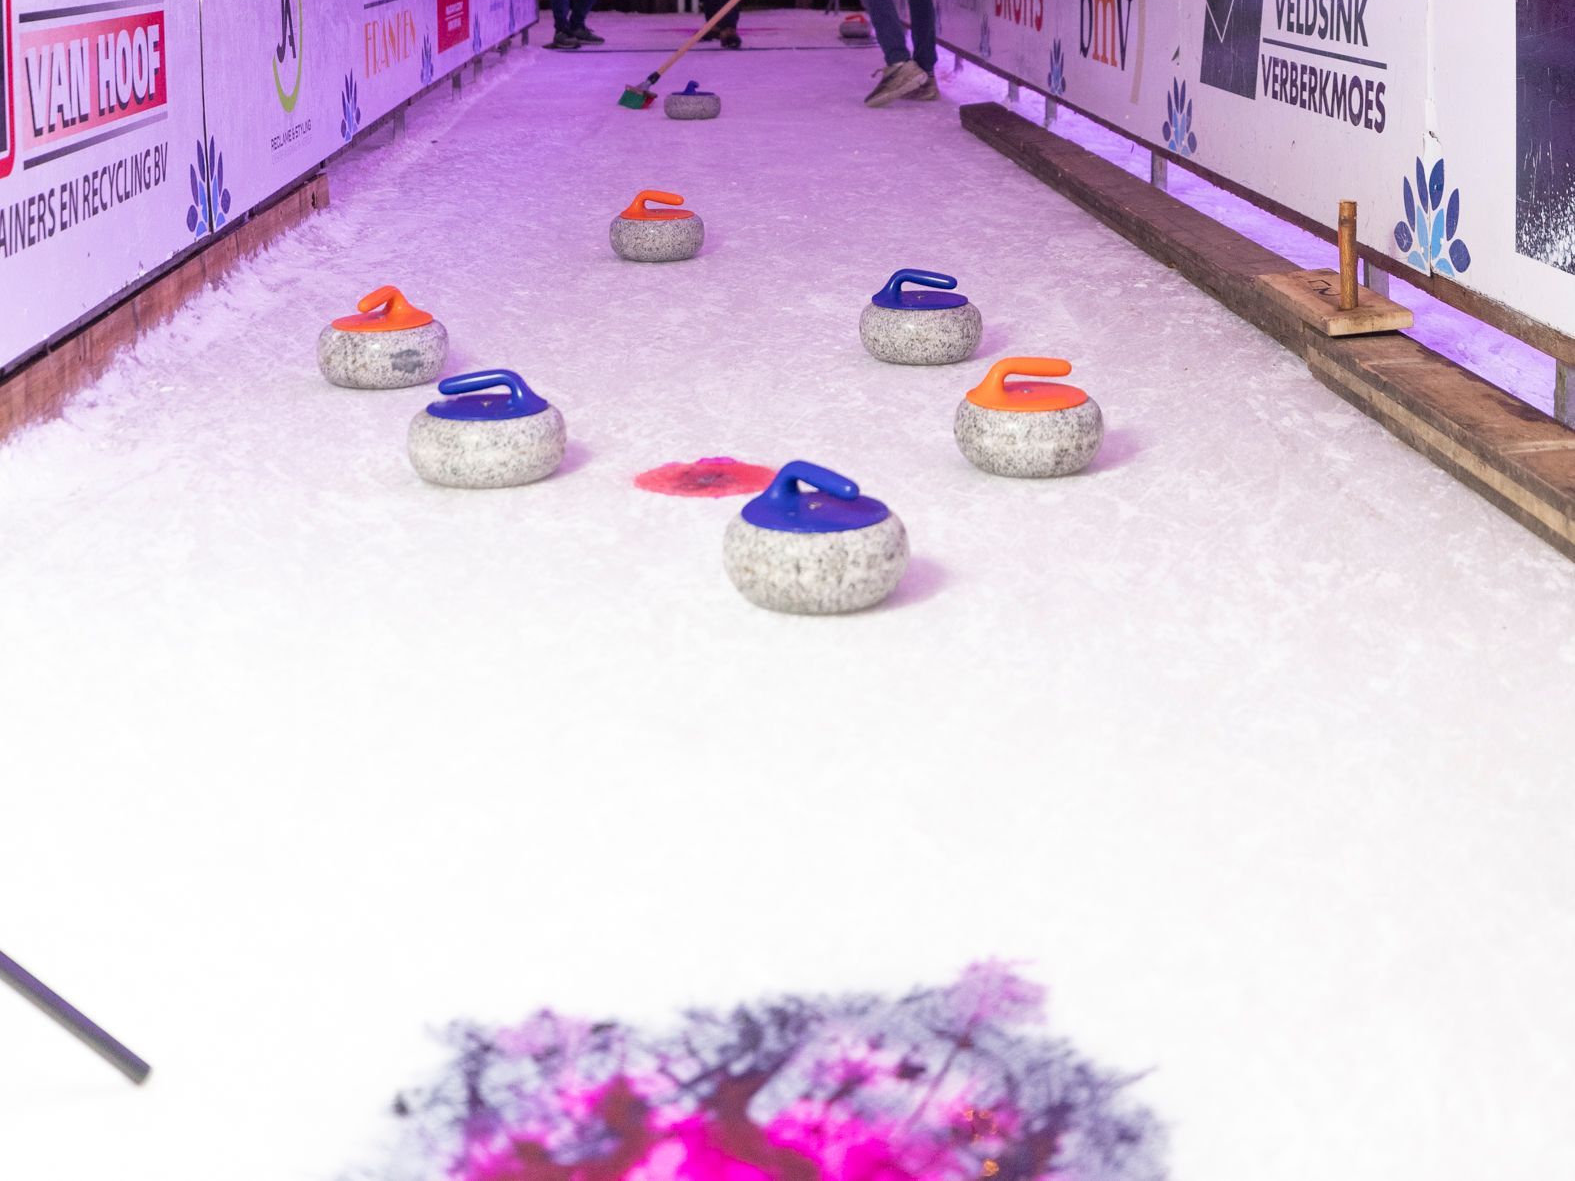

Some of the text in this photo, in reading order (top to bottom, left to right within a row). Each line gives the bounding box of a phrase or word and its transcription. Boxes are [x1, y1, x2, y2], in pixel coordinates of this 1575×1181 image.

[25, 24, 160, 137] VAN HOOF
[1261, 53, 1386, 134] VERBERKMOES
[60, 182, 79, 232] EN
[82, 149, 152, 220] RECYCLING
[154, 141, 168, 186] BV
